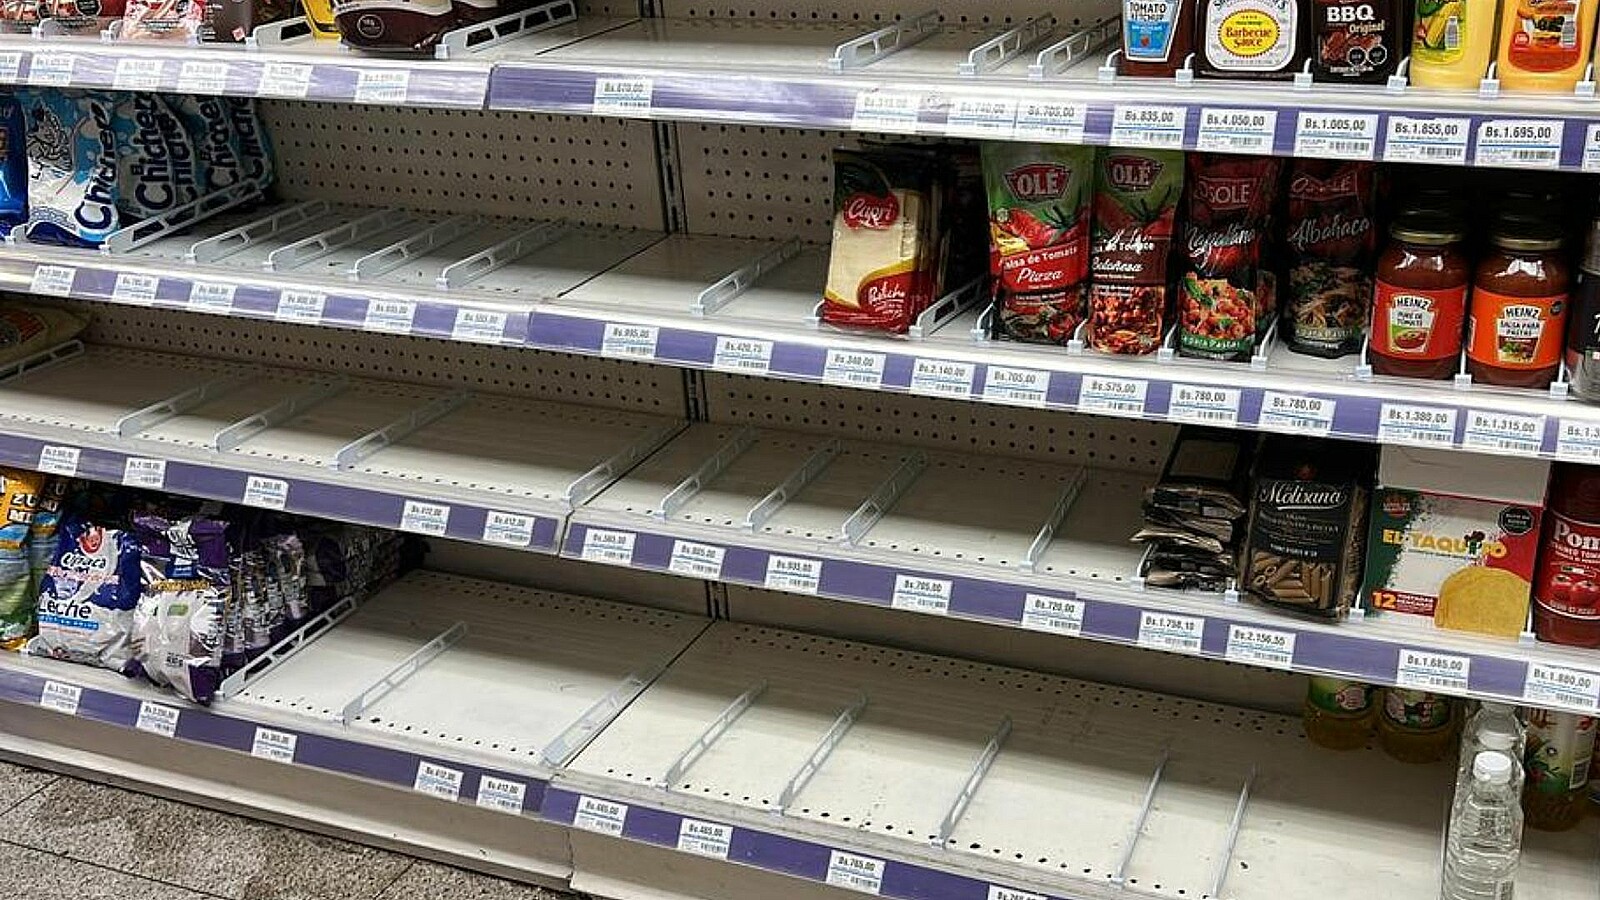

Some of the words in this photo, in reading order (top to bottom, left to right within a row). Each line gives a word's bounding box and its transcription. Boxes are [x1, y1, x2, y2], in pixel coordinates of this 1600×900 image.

[1326, 4, 1375, 23] BBQ
[1226, 26, 1272, 38] Barbecue
[1206, 113, 1265, 127] Bs.4.050,00
[1305, 117, 1366, 131] Bs.1.005,00
[1484, 126, 1552, 139] Bs.1.695,00
[1397, 297, 1429, 311] HEINZ
[1505, 307, 1539, 319] HEINZ
[1382, 529, 1402, 545] EL
[1372, 592, 1397, 608] 12
